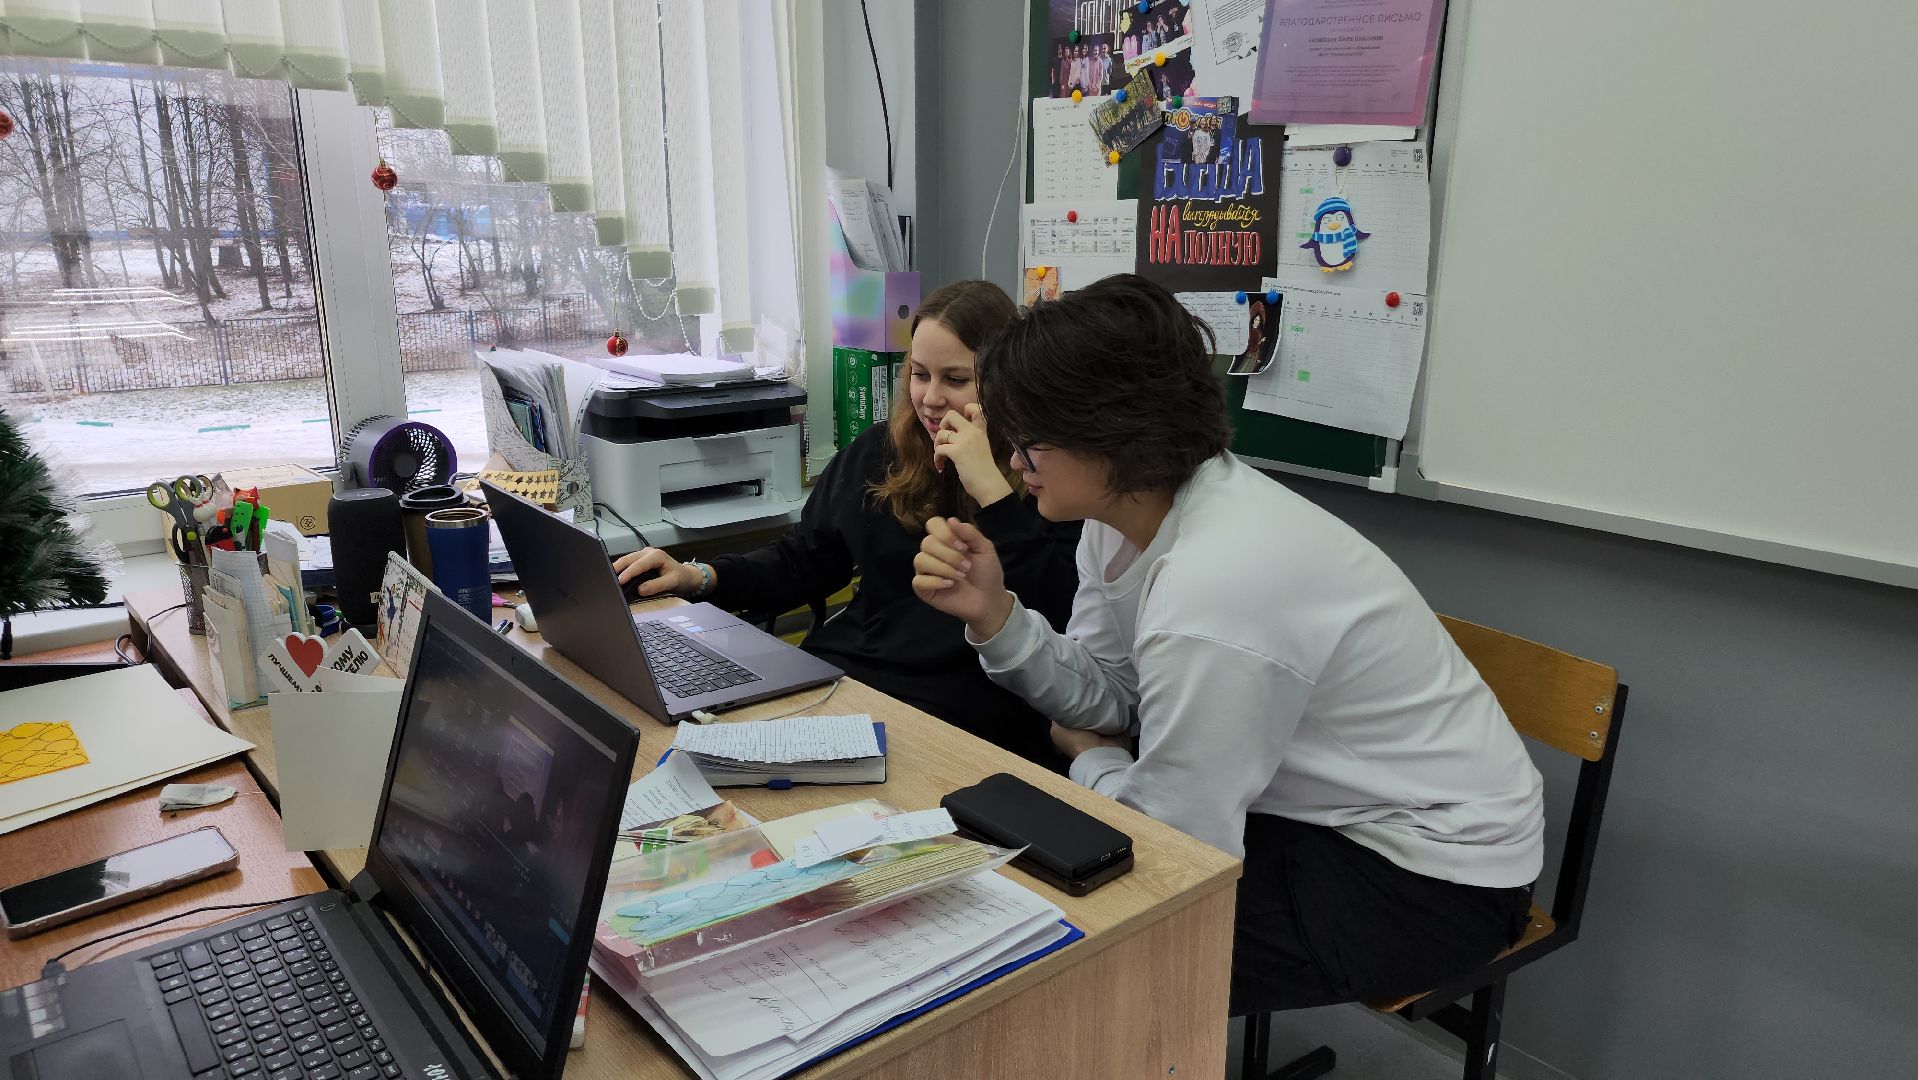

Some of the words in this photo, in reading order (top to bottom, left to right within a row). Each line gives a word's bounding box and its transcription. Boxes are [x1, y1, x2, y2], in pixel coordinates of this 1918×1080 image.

[1279, 13, 1375, 27] БЛАГОДАРСТВЕННОЕ
[1377, 11, 1423, 24] ПИСЬМО
[1149, 204, 1182, 265] НА
[1183, 229, 1263, 266] ПОЛНУЮ
